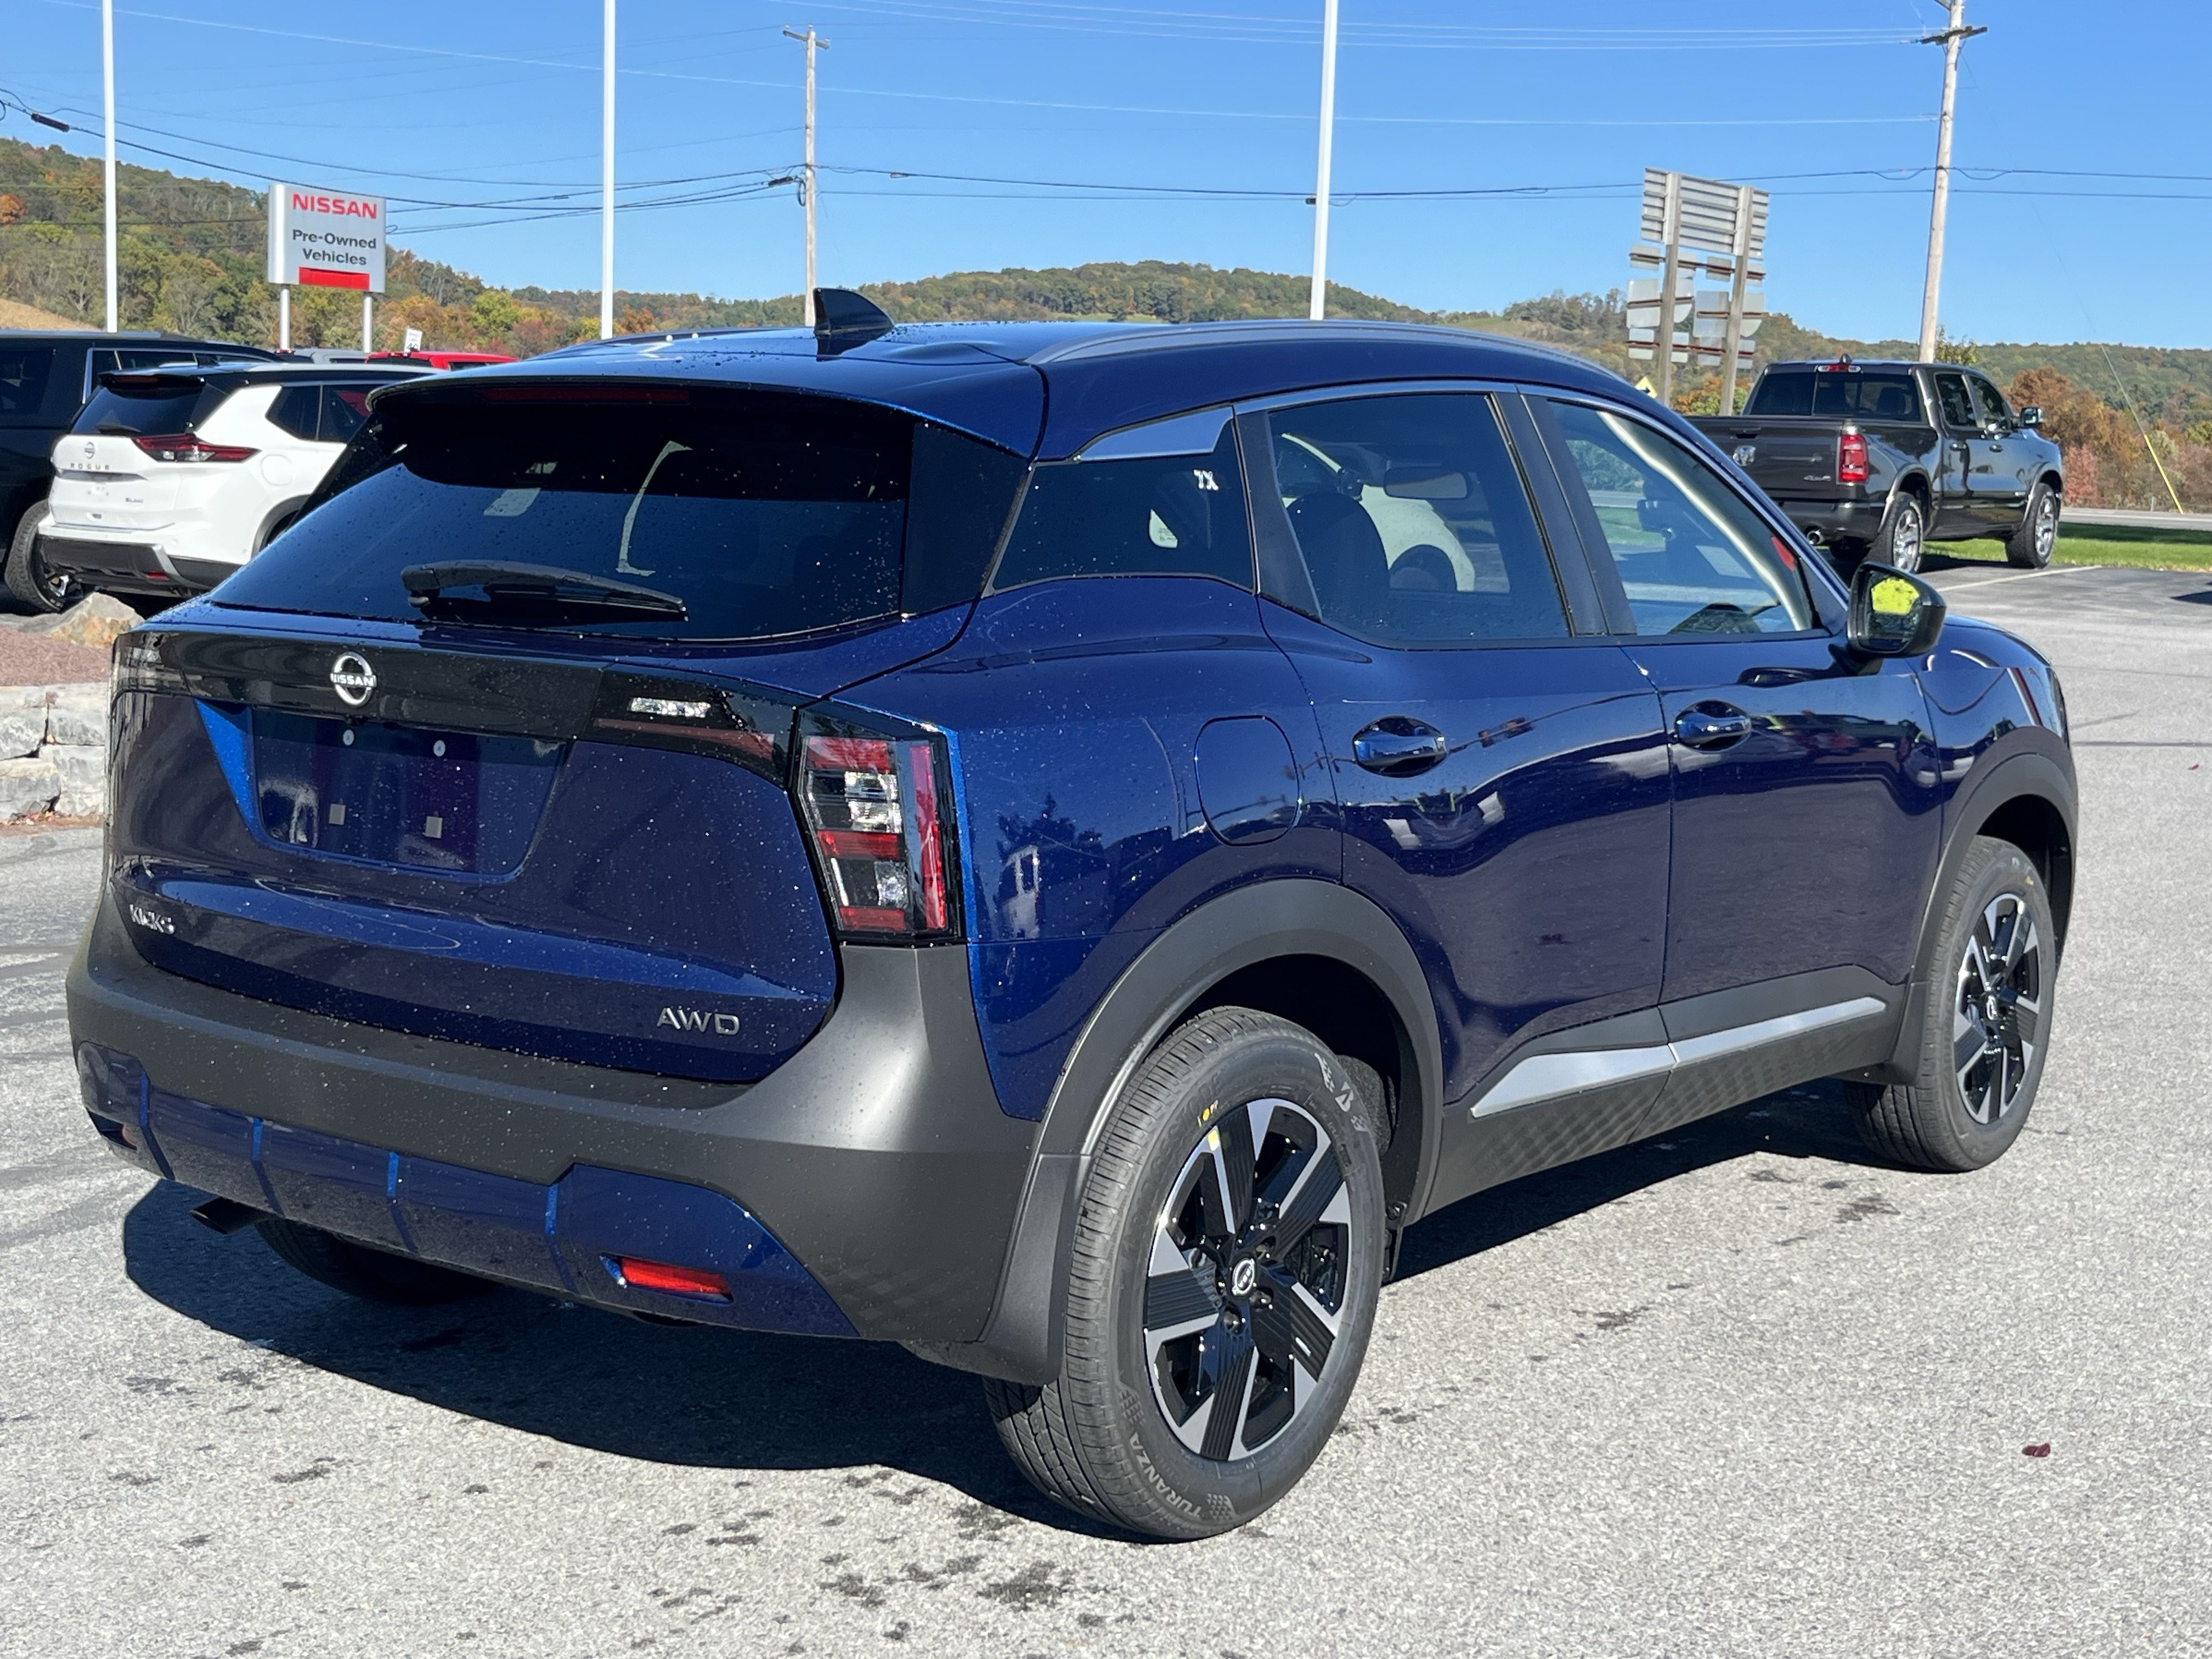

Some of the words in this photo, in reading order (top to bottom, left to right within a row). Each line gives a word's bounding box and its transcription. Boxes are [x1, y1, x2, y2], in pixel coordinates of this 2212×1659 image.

[292, 193, 377, 219] NISSAN
[292, 229, 376, 249] Pre-Owned
[303, 249, 367, 266] Vehicles
[656, 1007, 741, 1036] AWD
[1130, 1432, 1202, 1518] TURANZA
